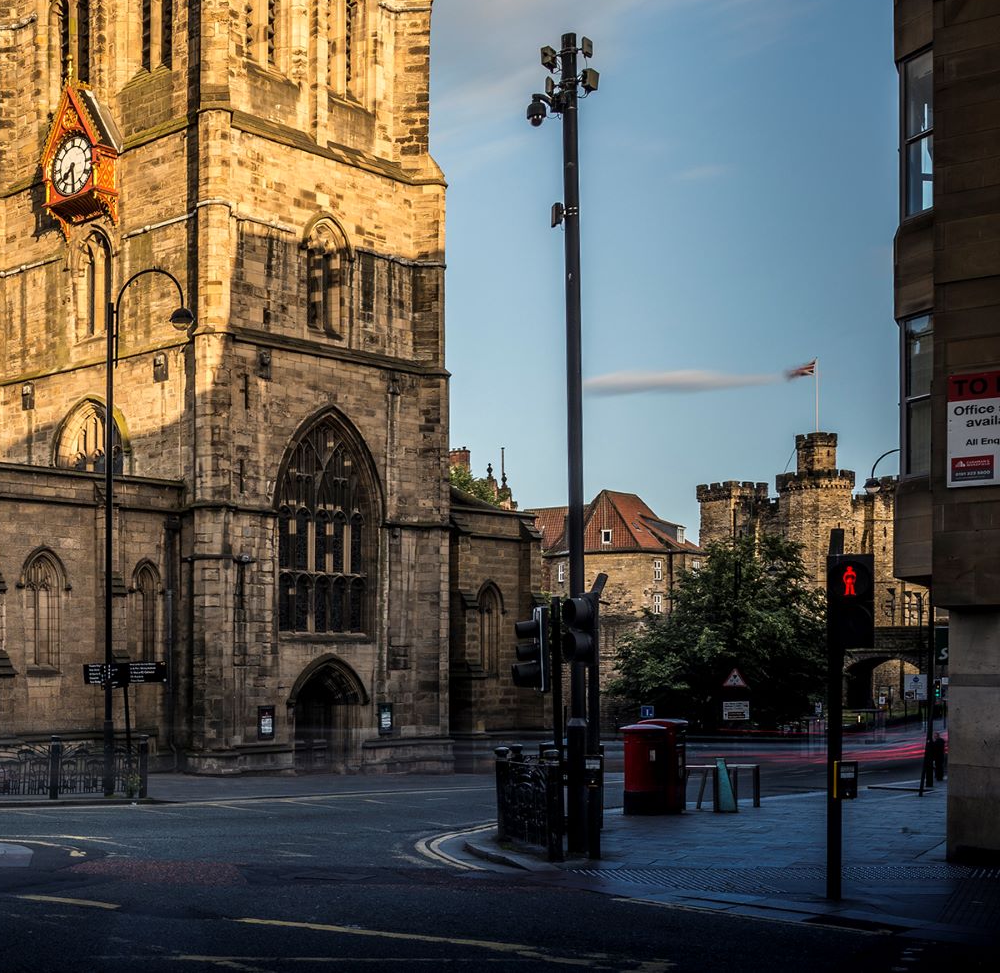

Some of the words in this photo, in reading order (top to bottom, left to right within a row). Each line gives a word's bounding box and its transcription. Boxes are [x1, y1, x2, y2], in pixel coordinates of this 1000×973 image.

[952, 378, 988, 396] TO
[954, 405, 995, 416] Office
[966, 415, 1000, 427] avail
[966, 438, 978, 446] All
